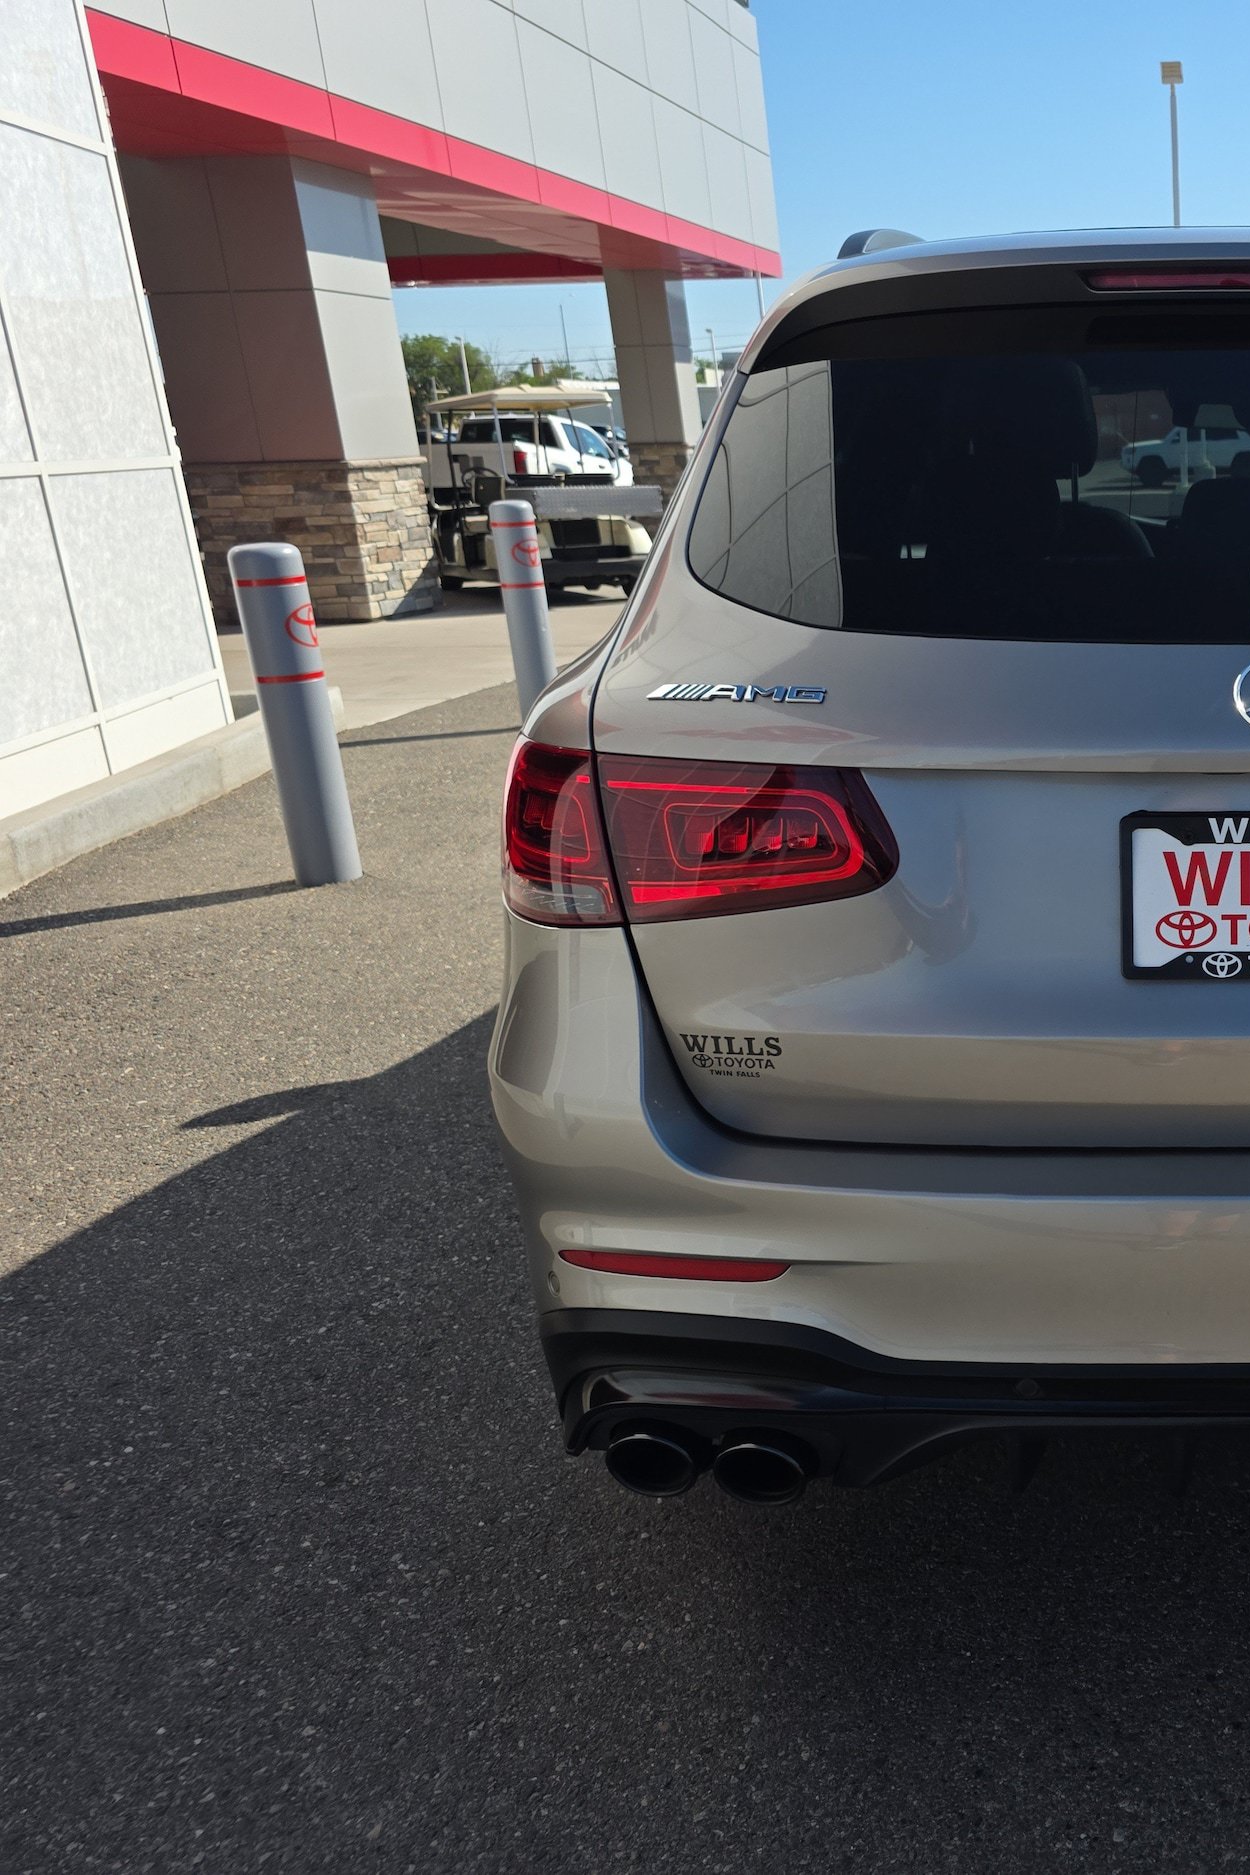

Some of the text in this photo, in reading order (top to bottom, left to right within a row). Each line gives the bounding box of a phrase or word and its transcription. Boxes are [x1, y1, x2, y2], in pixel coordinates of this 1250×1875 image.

[701, 684, 826, 703] AMG
[680, 1033, 782, 1056] WILLS
[714, 1056, 775, 1069] TOYOTA
[710, 1069, 760, 1078] TWIN FALLS
